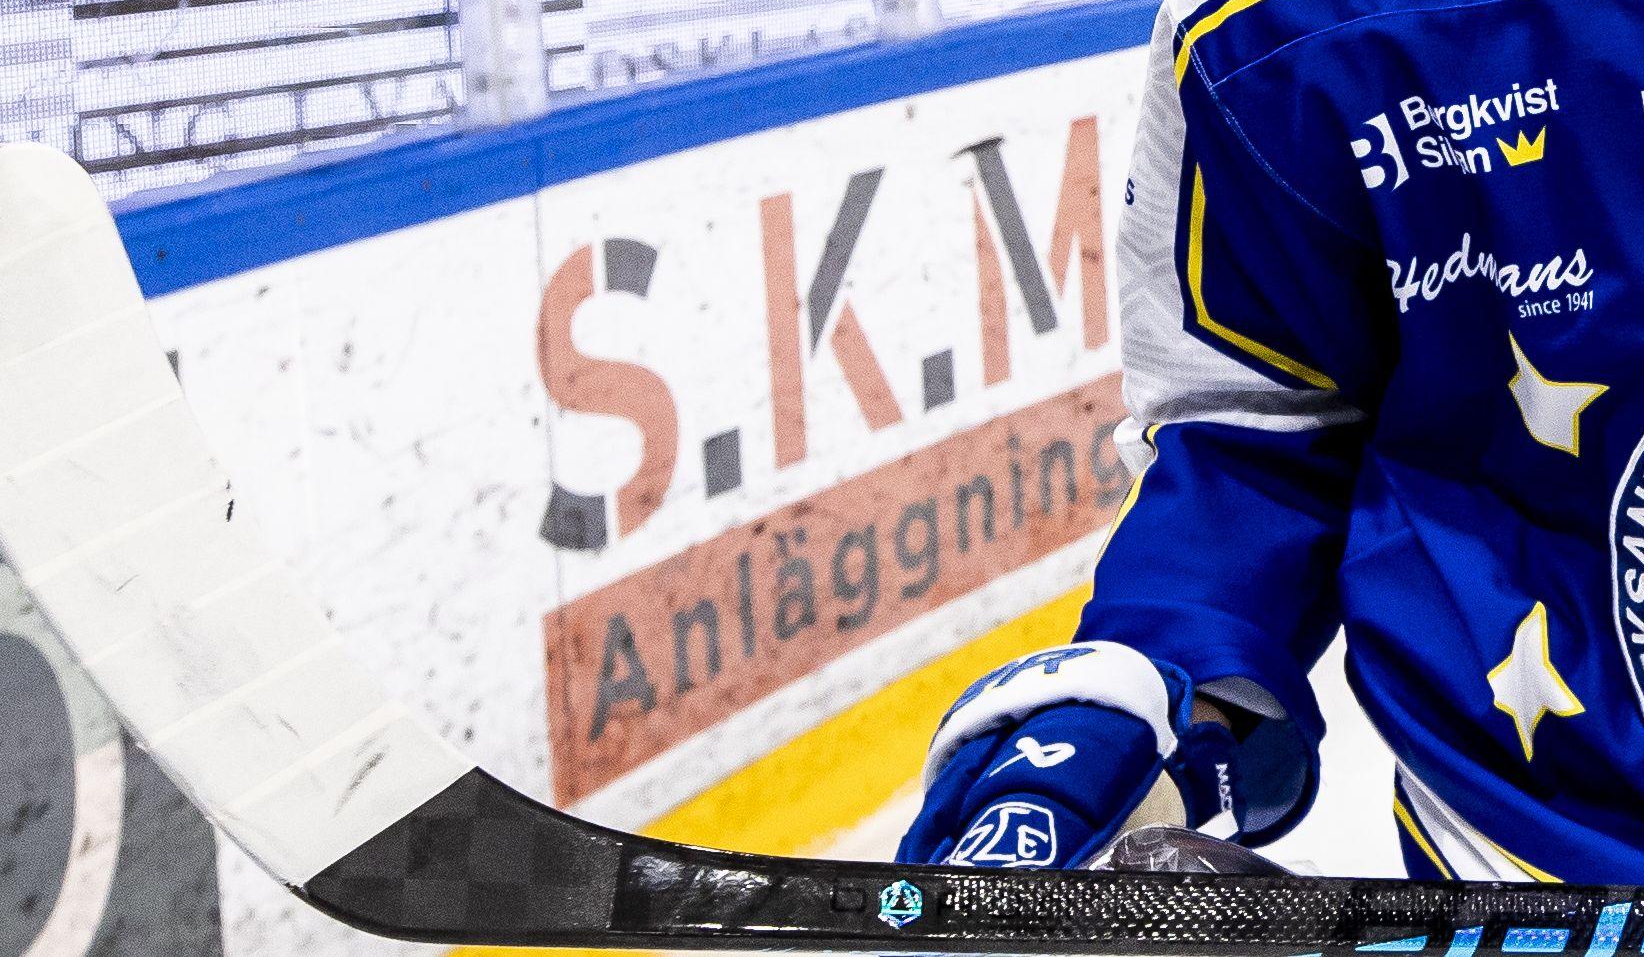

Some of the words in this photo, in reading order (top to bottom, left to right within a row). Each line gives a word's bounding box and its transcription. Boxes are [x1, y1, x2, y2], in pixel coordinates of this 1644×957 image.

[1399, 78, 1560, 141] Brgkvist
[1518, 298, 1562, 319] since
[1565, 289, 1595, 312] 1941
